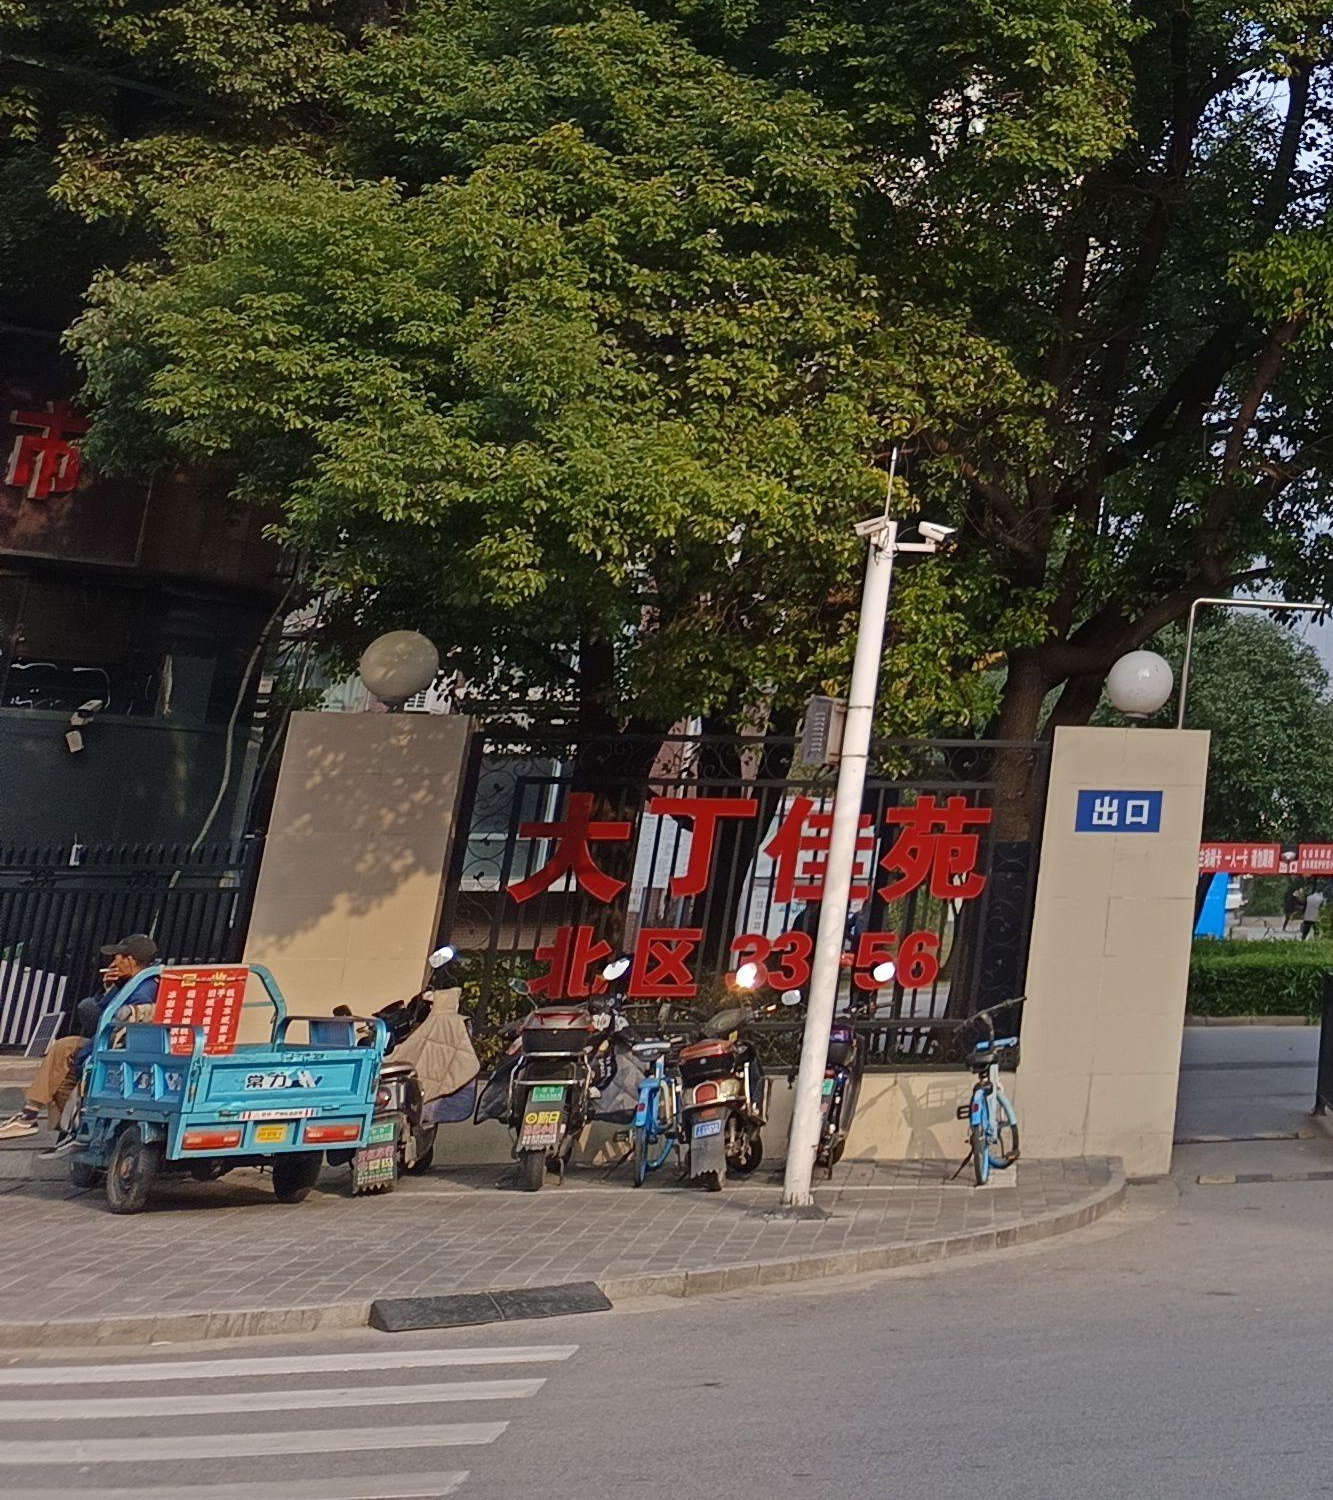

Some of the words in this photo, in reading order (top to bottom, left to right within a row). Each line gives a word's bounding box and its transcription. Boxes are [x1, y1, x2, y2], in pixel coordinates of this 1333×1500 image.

[1092, 796, 1150, 826] 出口
[506, 793, 993, 903] 大丁佳苑
[528, 925, 703, 998] 北区
